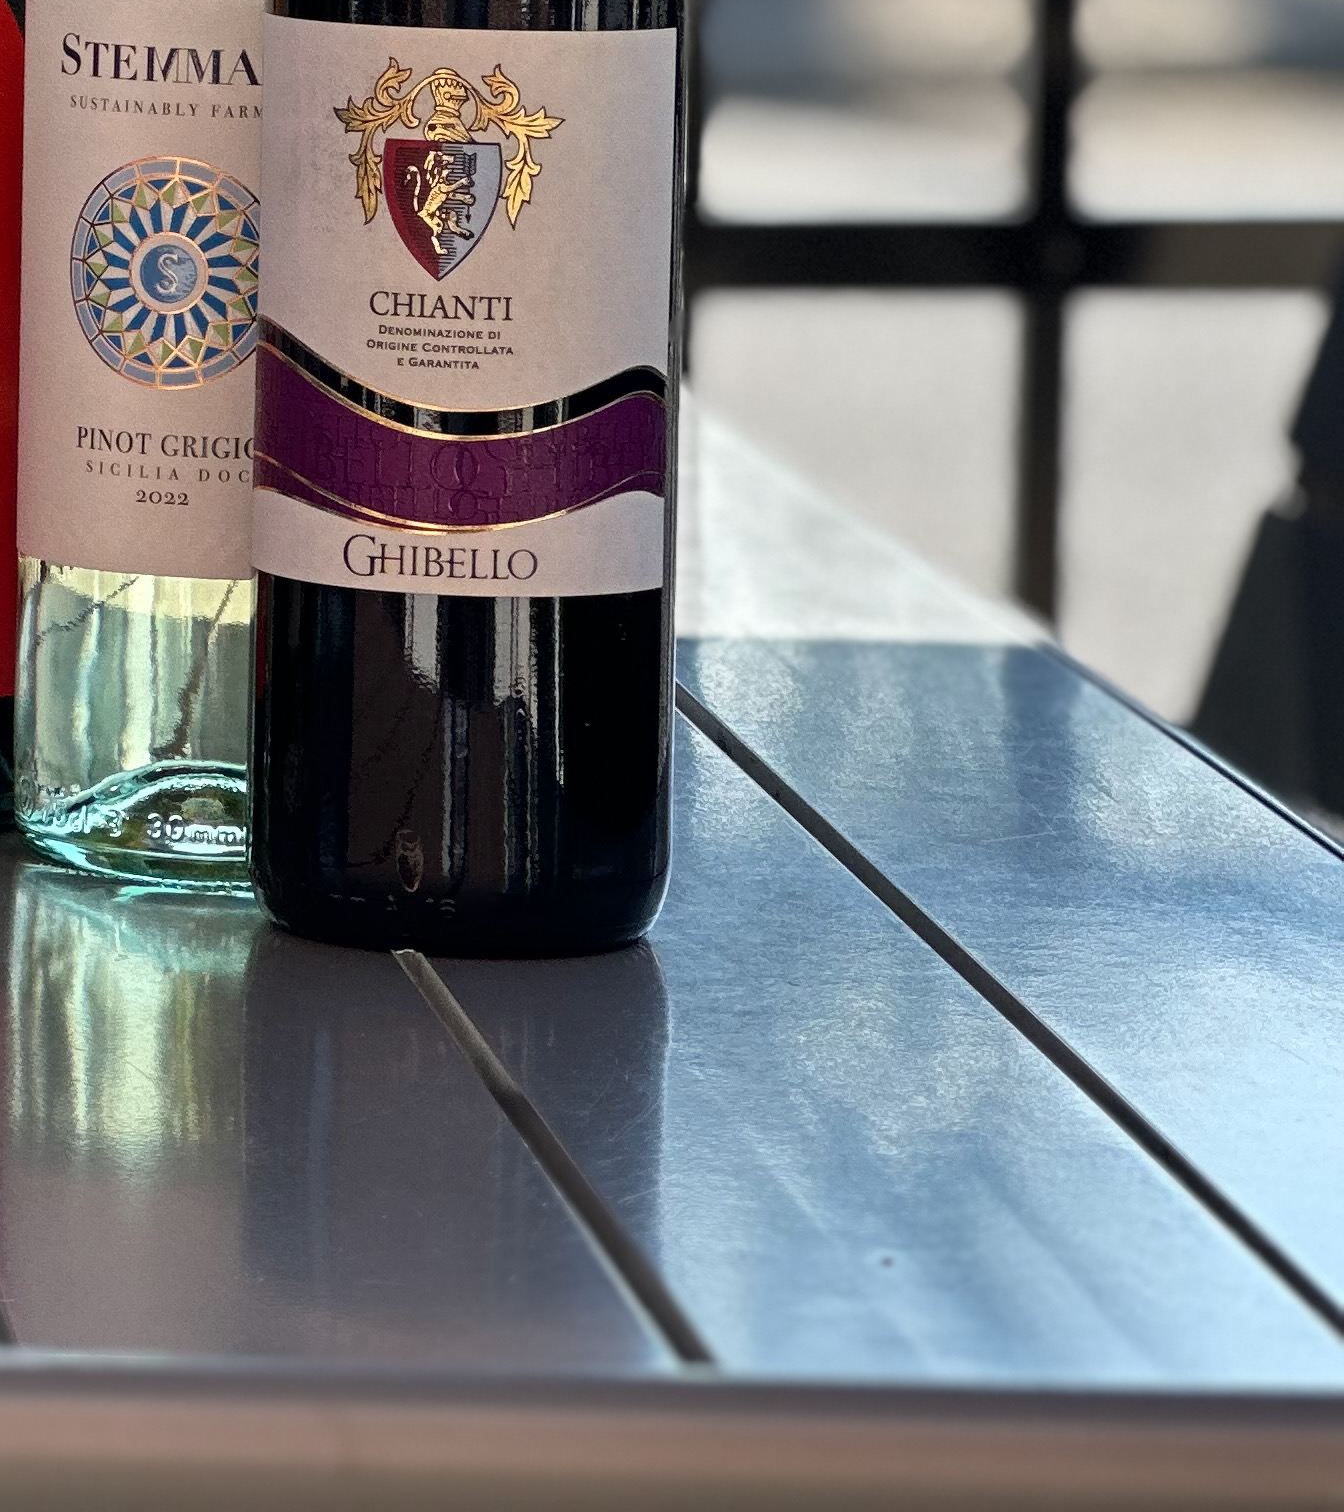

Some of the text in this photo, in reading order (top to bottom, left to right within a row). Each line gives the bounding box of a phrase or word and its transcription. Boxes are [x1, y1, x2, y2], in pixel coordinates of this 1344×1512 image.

[70, 94, 199, 117] SUSTAINABLY
[369, 290, 514, 322] CHIANTI
[378, 324, 501, 341] DENOMINAZIONE DI
[366, 339, 514, 356] ORIGINE CONTROLLATA
[408, 356, 480, 370] GARANTITA
[76, 425, 152, 455] PINOT
[85, 459, 250, 483] SICILIA DOC
[135, 489, 190, 507] 2022
[342, 533, 539, 580] GHIBELLO
